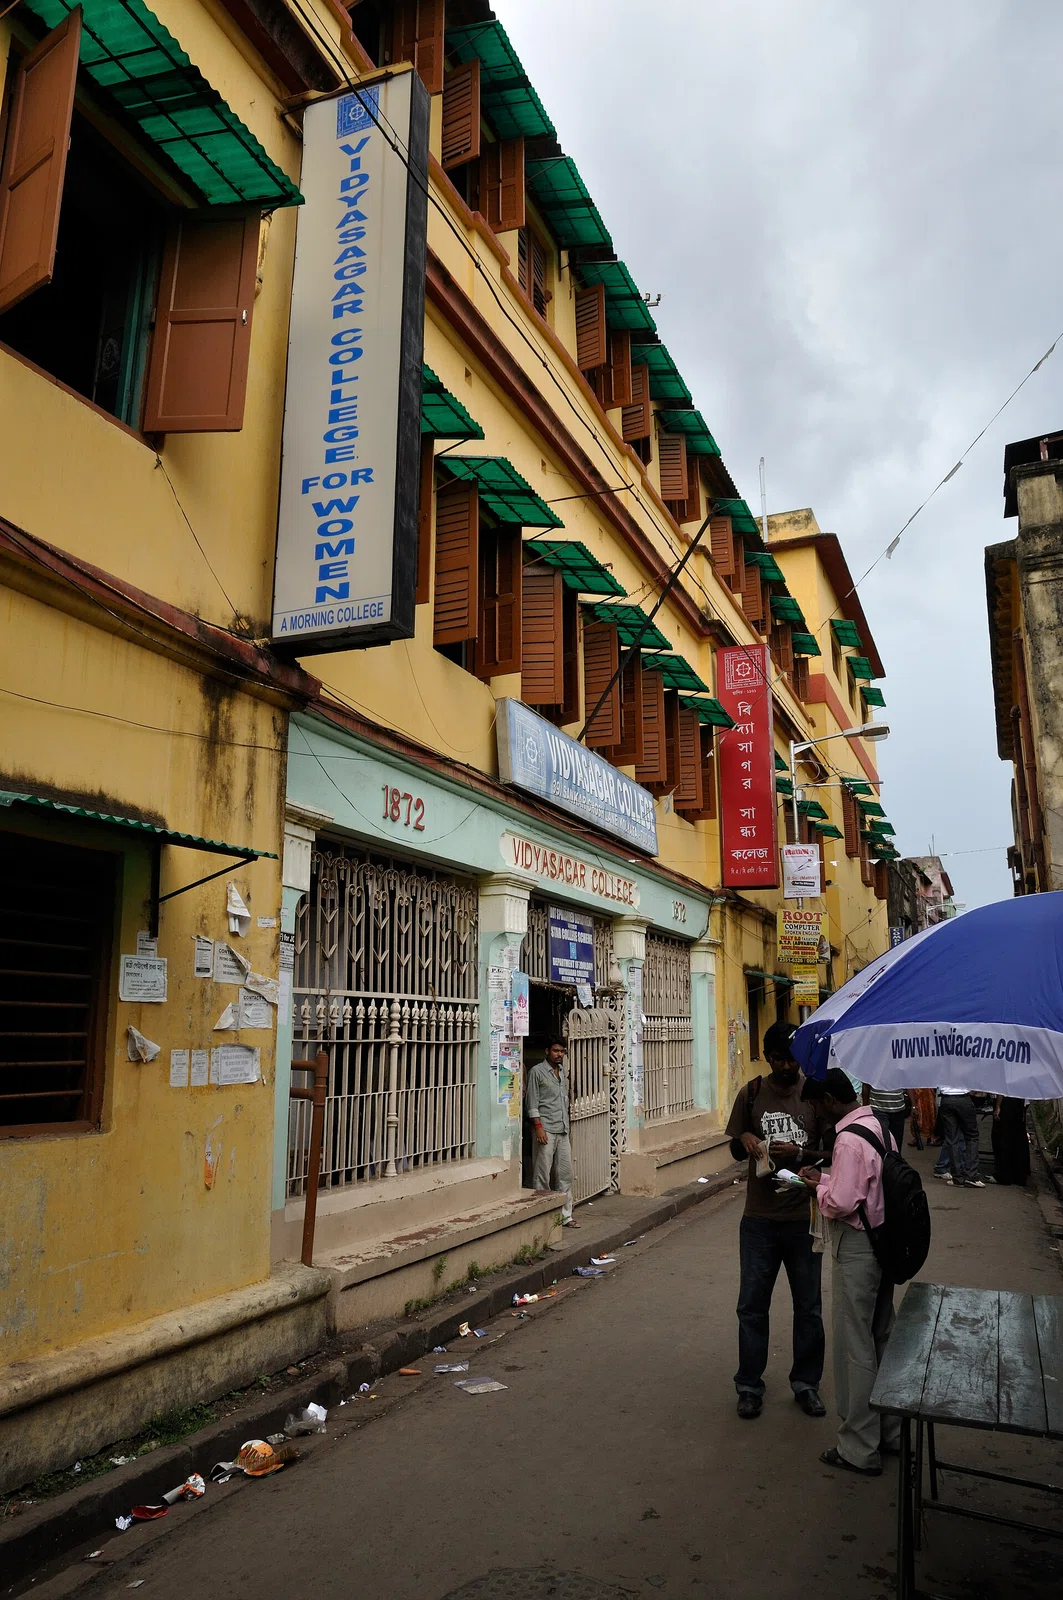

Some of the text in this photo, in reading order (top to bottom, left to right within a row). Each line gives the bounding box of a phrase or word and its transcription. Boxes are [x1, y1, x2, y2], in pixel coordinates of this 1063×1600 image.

[330, 135, 372, 320] VIDYASAGAR
[322, 327, 364, 465] COLLEGE
[301, 467, 375, 495] FOR
[311, 495, 361, 604] WOMEN
[280, 602, 384, 632] A MORNING COLLEGE
[545, 730, 656, 834] VIDYASAGAR COLLEGE
[381, 784, 425, 831] 1872
[731, 848, 769, 860] কলেজ
[782, 911, 823, 922] ROOT
[784, 923, 820, 931] COMPUTER
[891, 1027, 1031, 1065] www.indiacan.com
